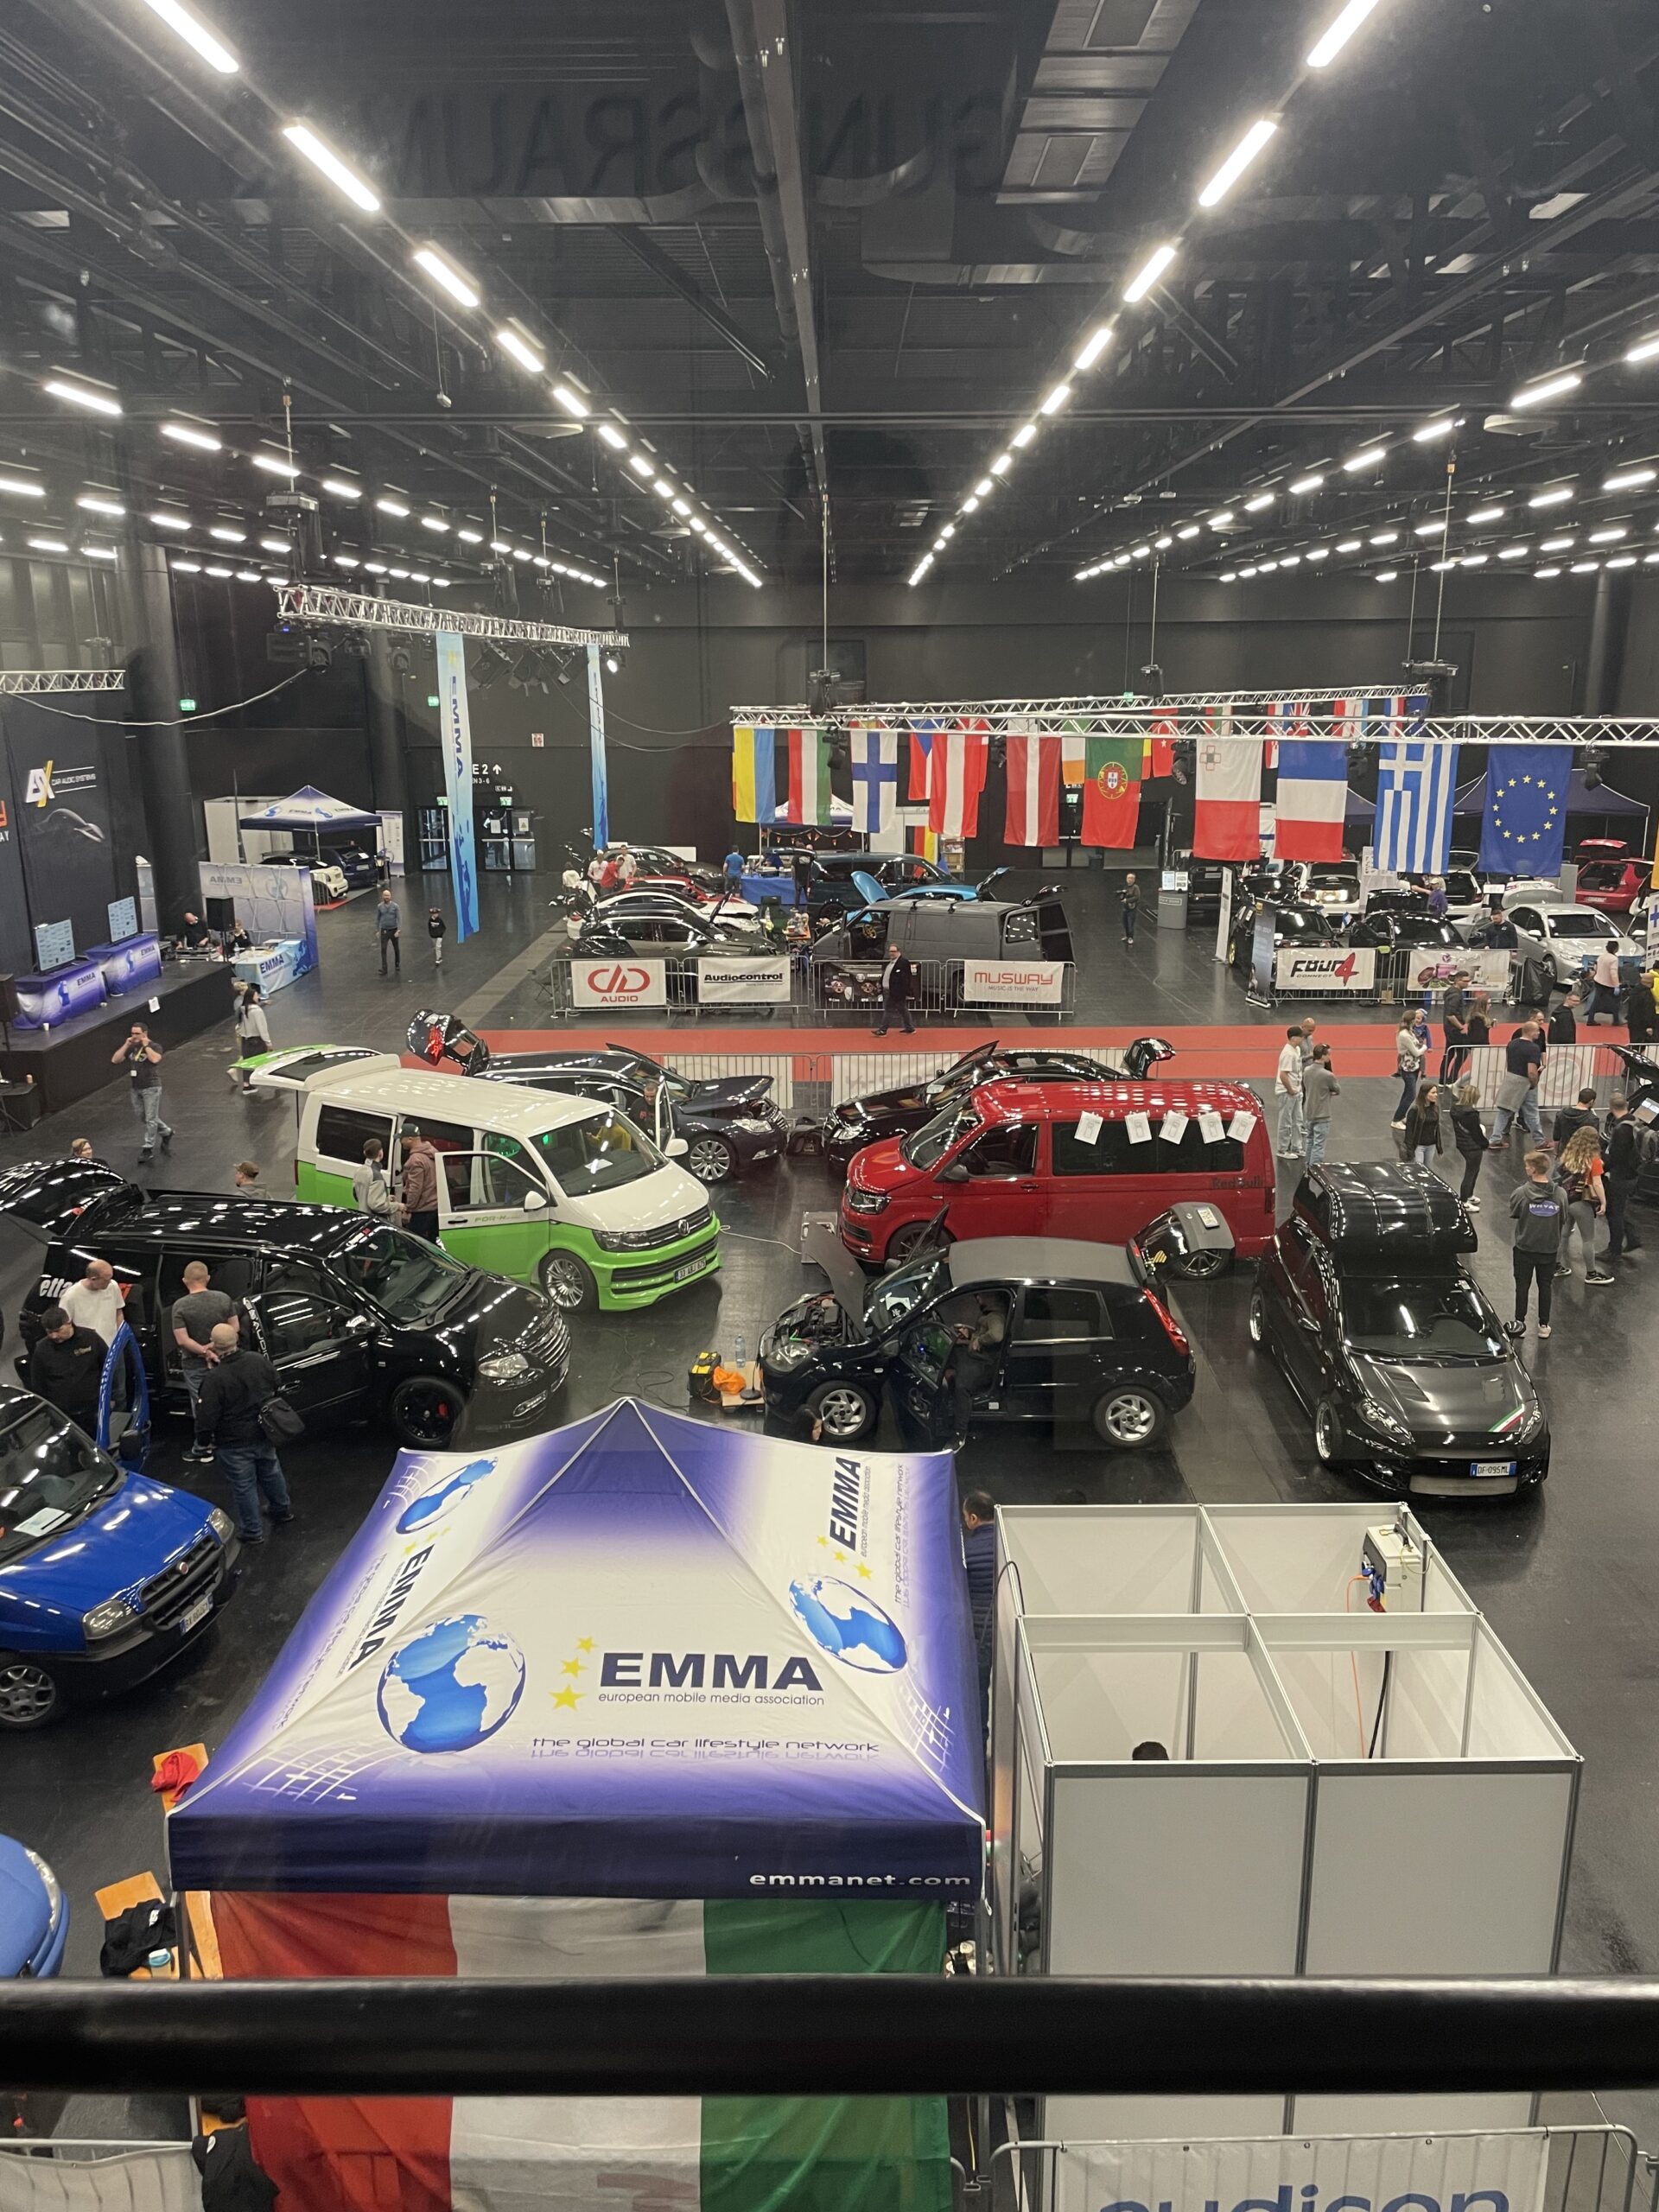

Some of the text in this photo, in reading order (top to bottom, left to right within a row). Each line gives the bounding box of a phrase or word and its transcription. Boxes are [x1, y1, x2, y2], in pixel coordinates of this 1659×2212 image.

[451, 676, 464, 779] EMMA
[482, 764, 488, 774] 2
[140, 944, 156, 956] EMMA
[260, 954, 284, 974] EMMA
[77, 972, 96, 986] EMMA
[974, 972, 1053, 985] MUSWAY
[830, 1457, 861, 1552] EMMA
[347, 1543, 435, 1672] EMMA
[600, 1652, 824, 1691] EMMA
[598, 1692, 824, 1706] european mobile media association
[532, 1738, 880, 1752] the global car lifestyle network
[749, 1874, 970, 1885] emmanet.com
